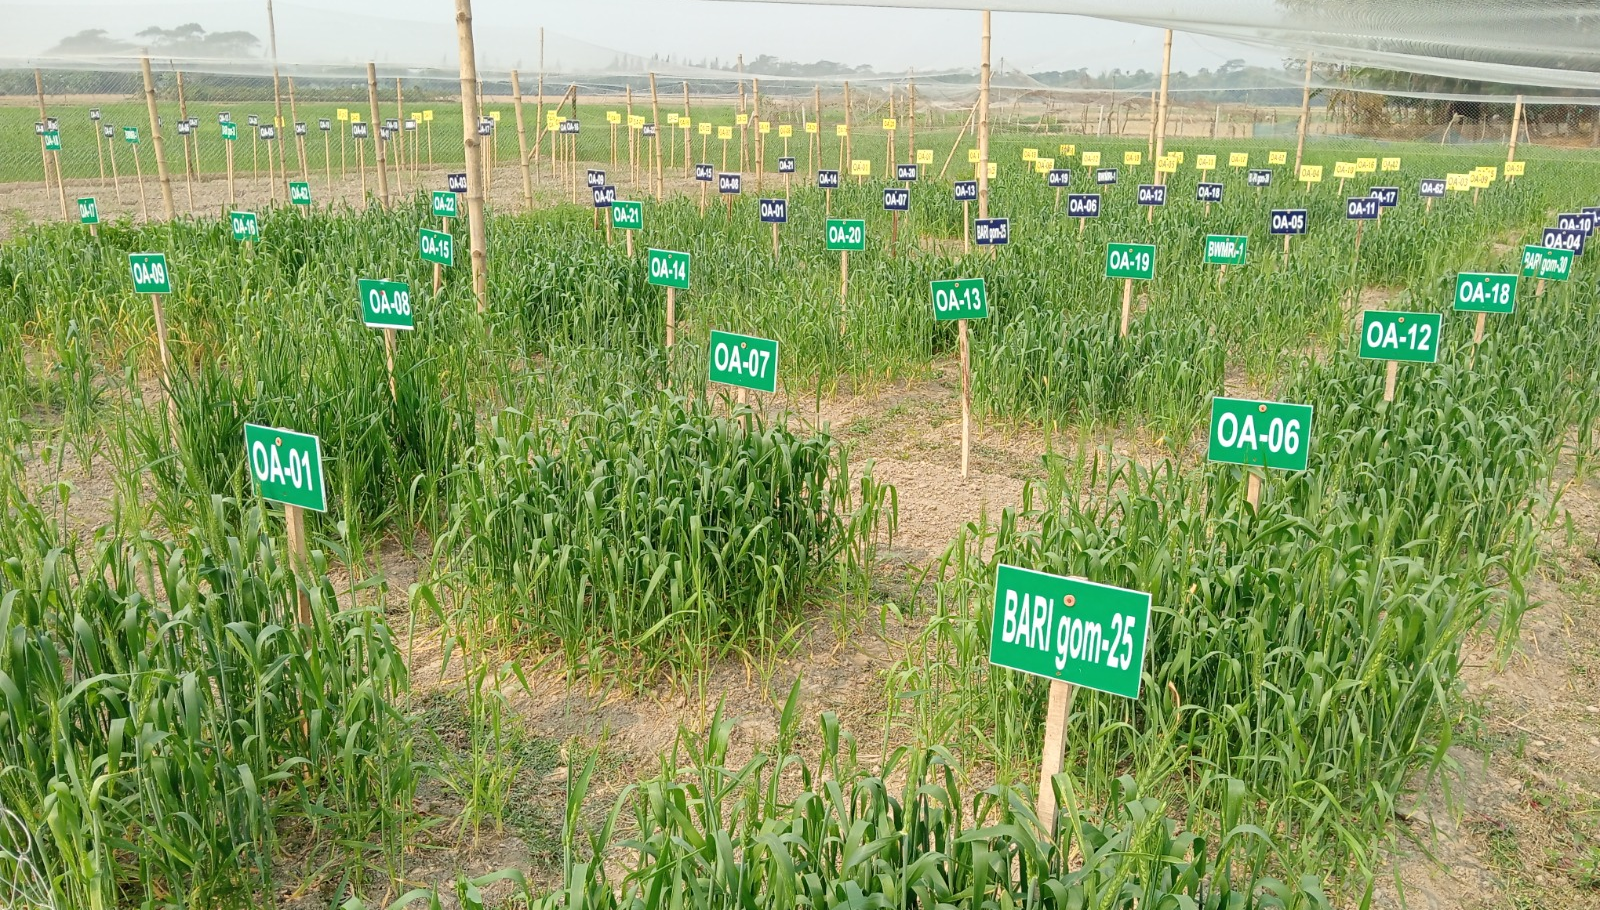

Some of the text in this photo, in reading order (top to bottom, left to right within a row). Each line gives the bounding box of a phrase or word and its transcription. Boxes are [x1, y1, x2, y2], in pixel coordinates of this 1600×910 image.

[697, 167, 712, 178] OA-15
[779, 161, 793, 170] OA-21
[898, 168, 916, 178] OA-20
[449, 176, 467, 189] OA-03
[588, 174, 604, 185] OA-09
[720, 178, 739, 190] OA-08
[819, 173, 837, 185] OA-14
[1050, 173, 1069, 184] OA-19
[1448, 177, 1469, 187] OA-03
[594, 189, 614, 202] OA-02
[955, 185, 976, 197] OA-13
[1139, 188, 1163, 201] OA-12
[1198, 187, 1220, 199] OA-18
[1421, 182, 1445, 194] OA-62
[434, 197, 454, 211] OA-22
[885, 193, 907, 206] OA-07
[1370, 191, 1396, 203] OA-17
[79, 202, 96, 218] OA-17
[761, 203, 784, 218] OA-01
[1070, 199, 1097, 213] OA-06
[1348, 202, 1376, 215] OA-11
[614, 207, 639, 223] OA-21
[1272, 214, 1304, 230] OA-05
[233, 218, 256, 236] OA-16
[1560, 218, 1591, 231] OA-10
[829, 226, 861, 244] OA-20
[977, 224, 1006, 243] BARI gom-25
[421, 236, 449, 259] OA-15
[1544, 233, 1581, 250] OA-04
[1110, 250, 1150, 271] OA-19
[1540, 256, 1569, 276] gom-30
[133, 262, 165, 284] OA-09
[651, 257, 686, 281] OA-14
[936, 288, 982, 312] OA-13
[1459, 281, 1511, 305] OA-18
[369, 288, 411, 316] OA-08
[1366, 321, 1432, 351] OA-12
[714, 342, 770, 379] OA-07
[1217, 412, 1301, 455] OA-06
[252, 440, 313, 491] OA-01
[1002, 589, 1136, 671] BARI gom-25
